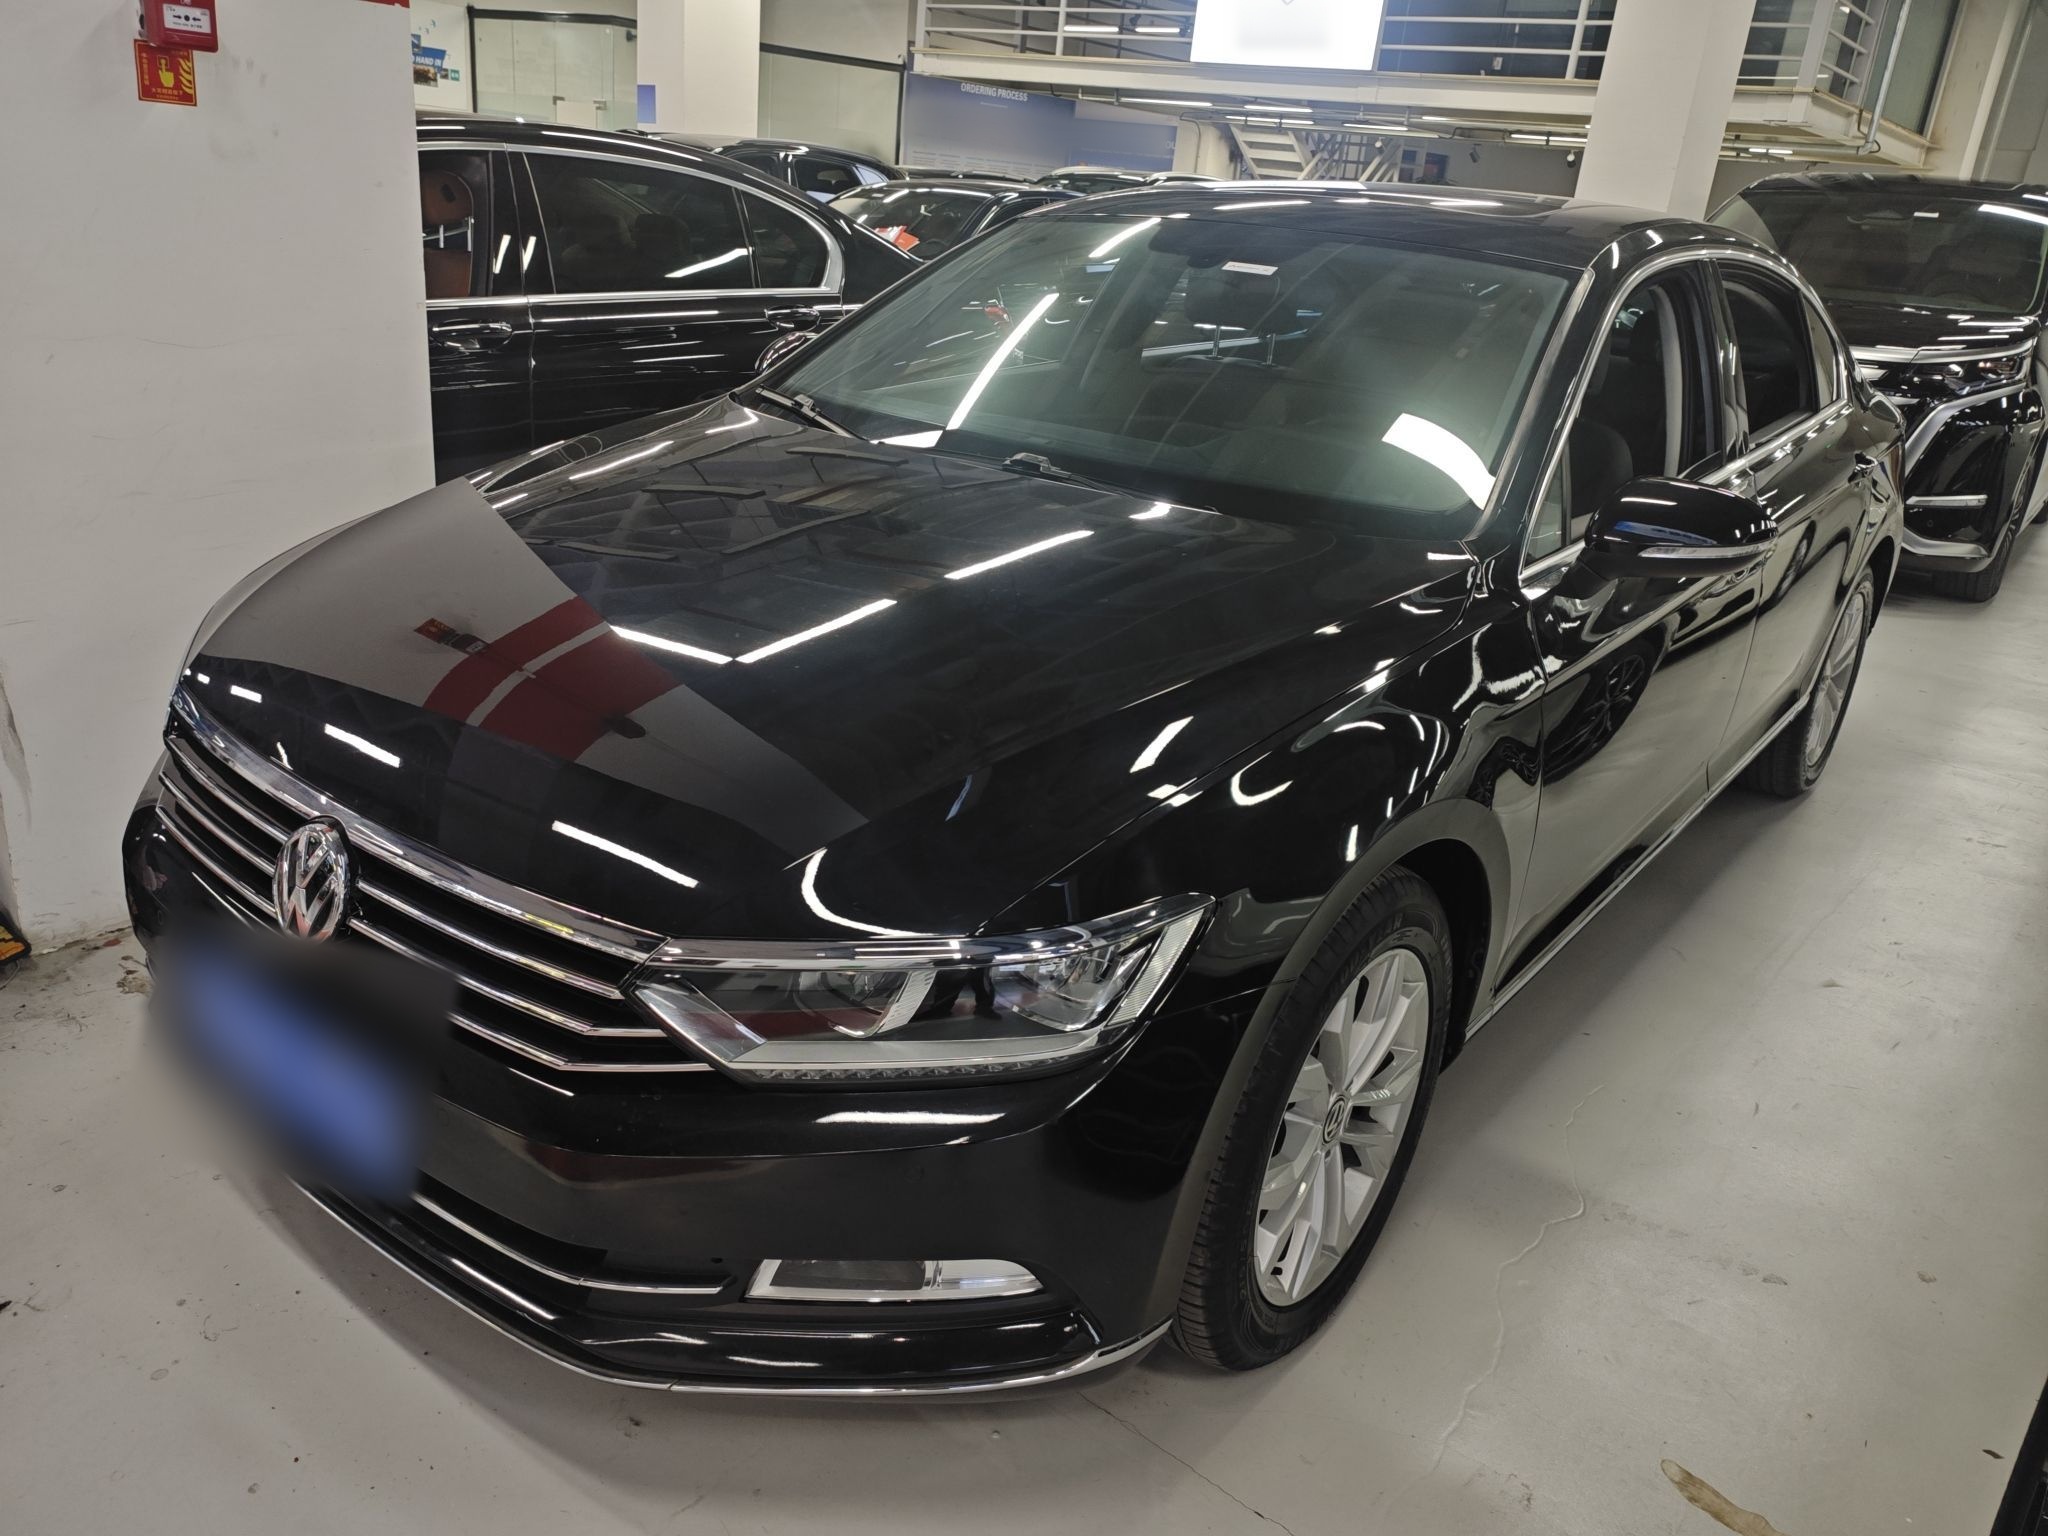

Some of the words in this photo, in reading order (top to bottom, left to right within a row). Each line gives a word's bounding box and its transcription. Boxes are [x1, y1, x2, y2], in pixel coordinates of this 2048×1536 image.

[416, 56, 434, 66] HAND
[960, 83, 997, 97] ORDERING
[997, 88, 1028, 101] PROCESS
[272, 823, 346, 940] VW
